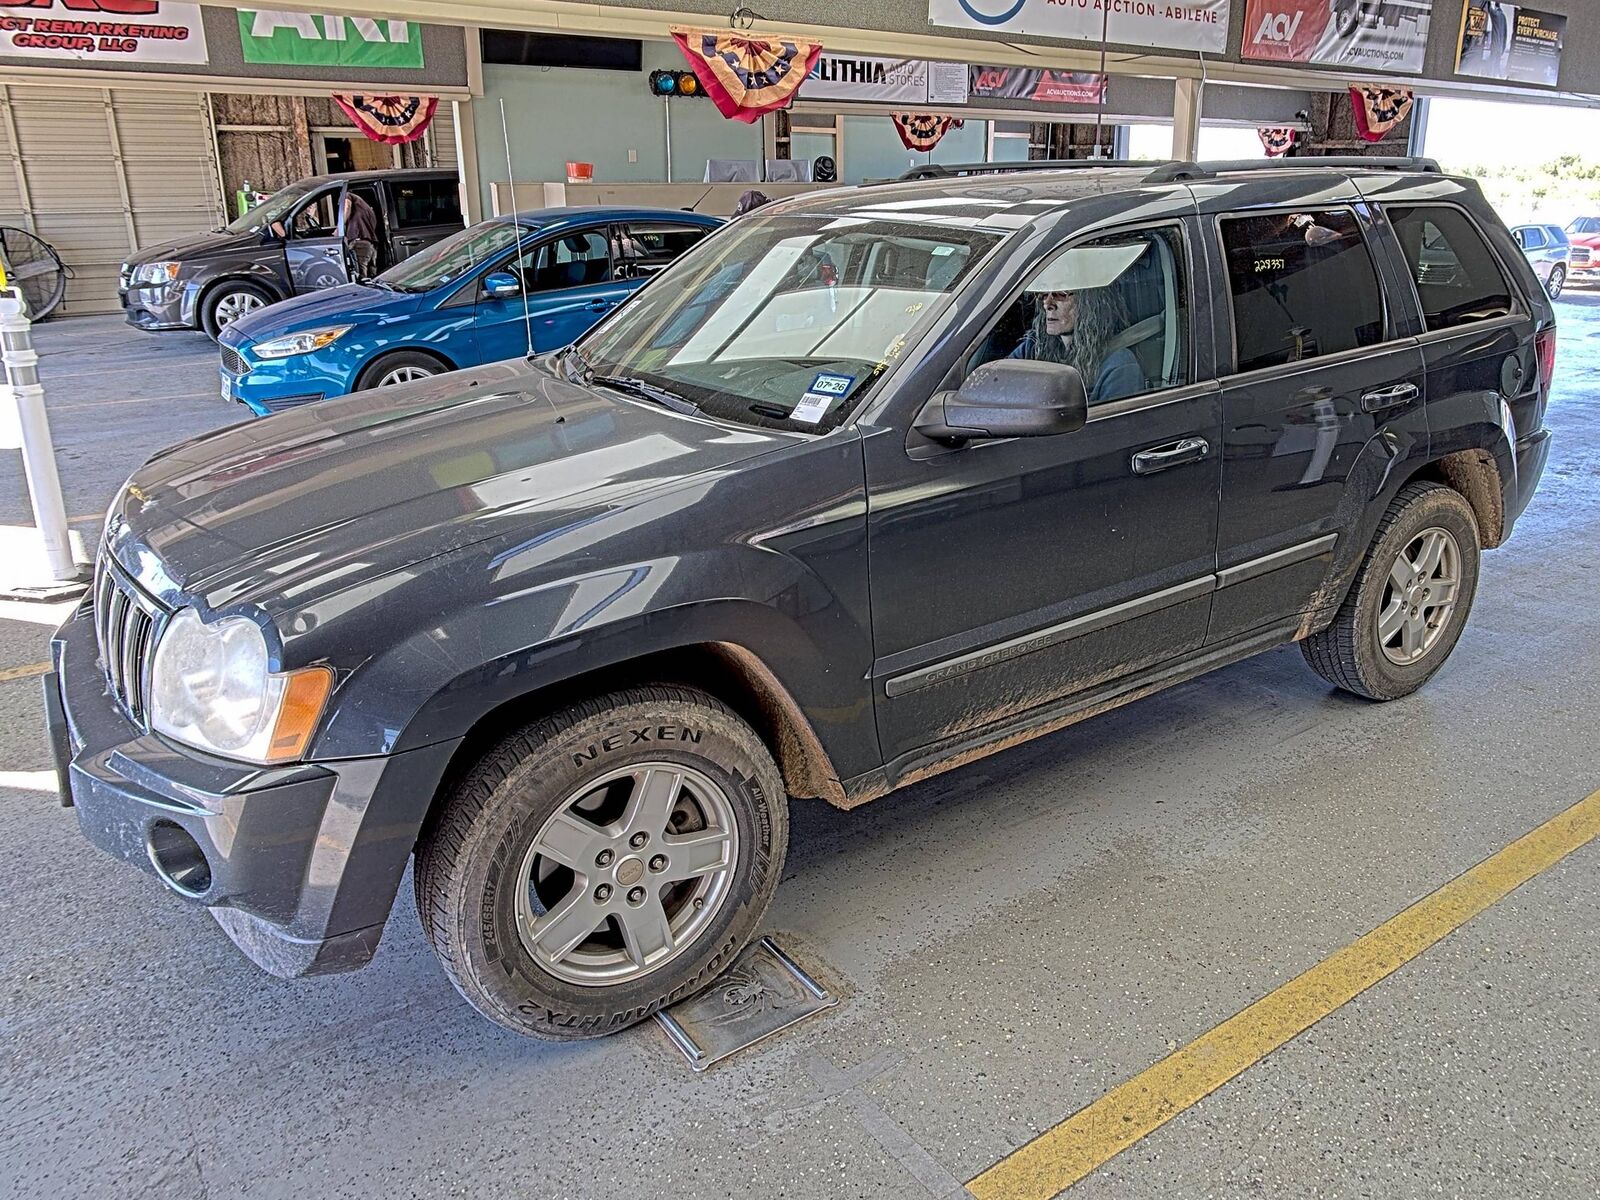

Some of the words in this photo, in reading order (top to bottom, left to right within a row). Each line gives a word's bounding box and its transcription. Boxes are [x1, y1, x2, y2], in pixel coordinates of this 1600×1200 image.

[1093, 0, 1155, 17] AUCTION
[1165, 6, 1217, 24] ABILENE
[1517, 15, 1541, 27] PROTECT
[0, 16, 33, 31] CT
[33, 18, 189, 40] REMARKETING
[1252, 10, 1304, 44] ACV
[1516, 25, 1533, 36] EVERY
[12, 33, 95, 52] GROUP,
[98, 38, 138, 52] LLC
[820, 57, 887, 85] LITHIA
[889, 63, 914, 75] AUTO
[889, 74, 925, 87] STORES
[976, 69, 1009, 90] ACV
[816, 380, 829, 389] 07
[832, 382, 846, 392] 26
[925, 658, 977, 682] GRAND
[982, 635, 1052, 665] CHEROKEE
[572, 725, 704, 768] NEXEN
[751, 787, 771, 847] All-Weather
[483, 880, 496, 946] 245/65R17
[607, 933, 737, 1028] ROADIAN
[518, 998, 606, 1029] HTX2
